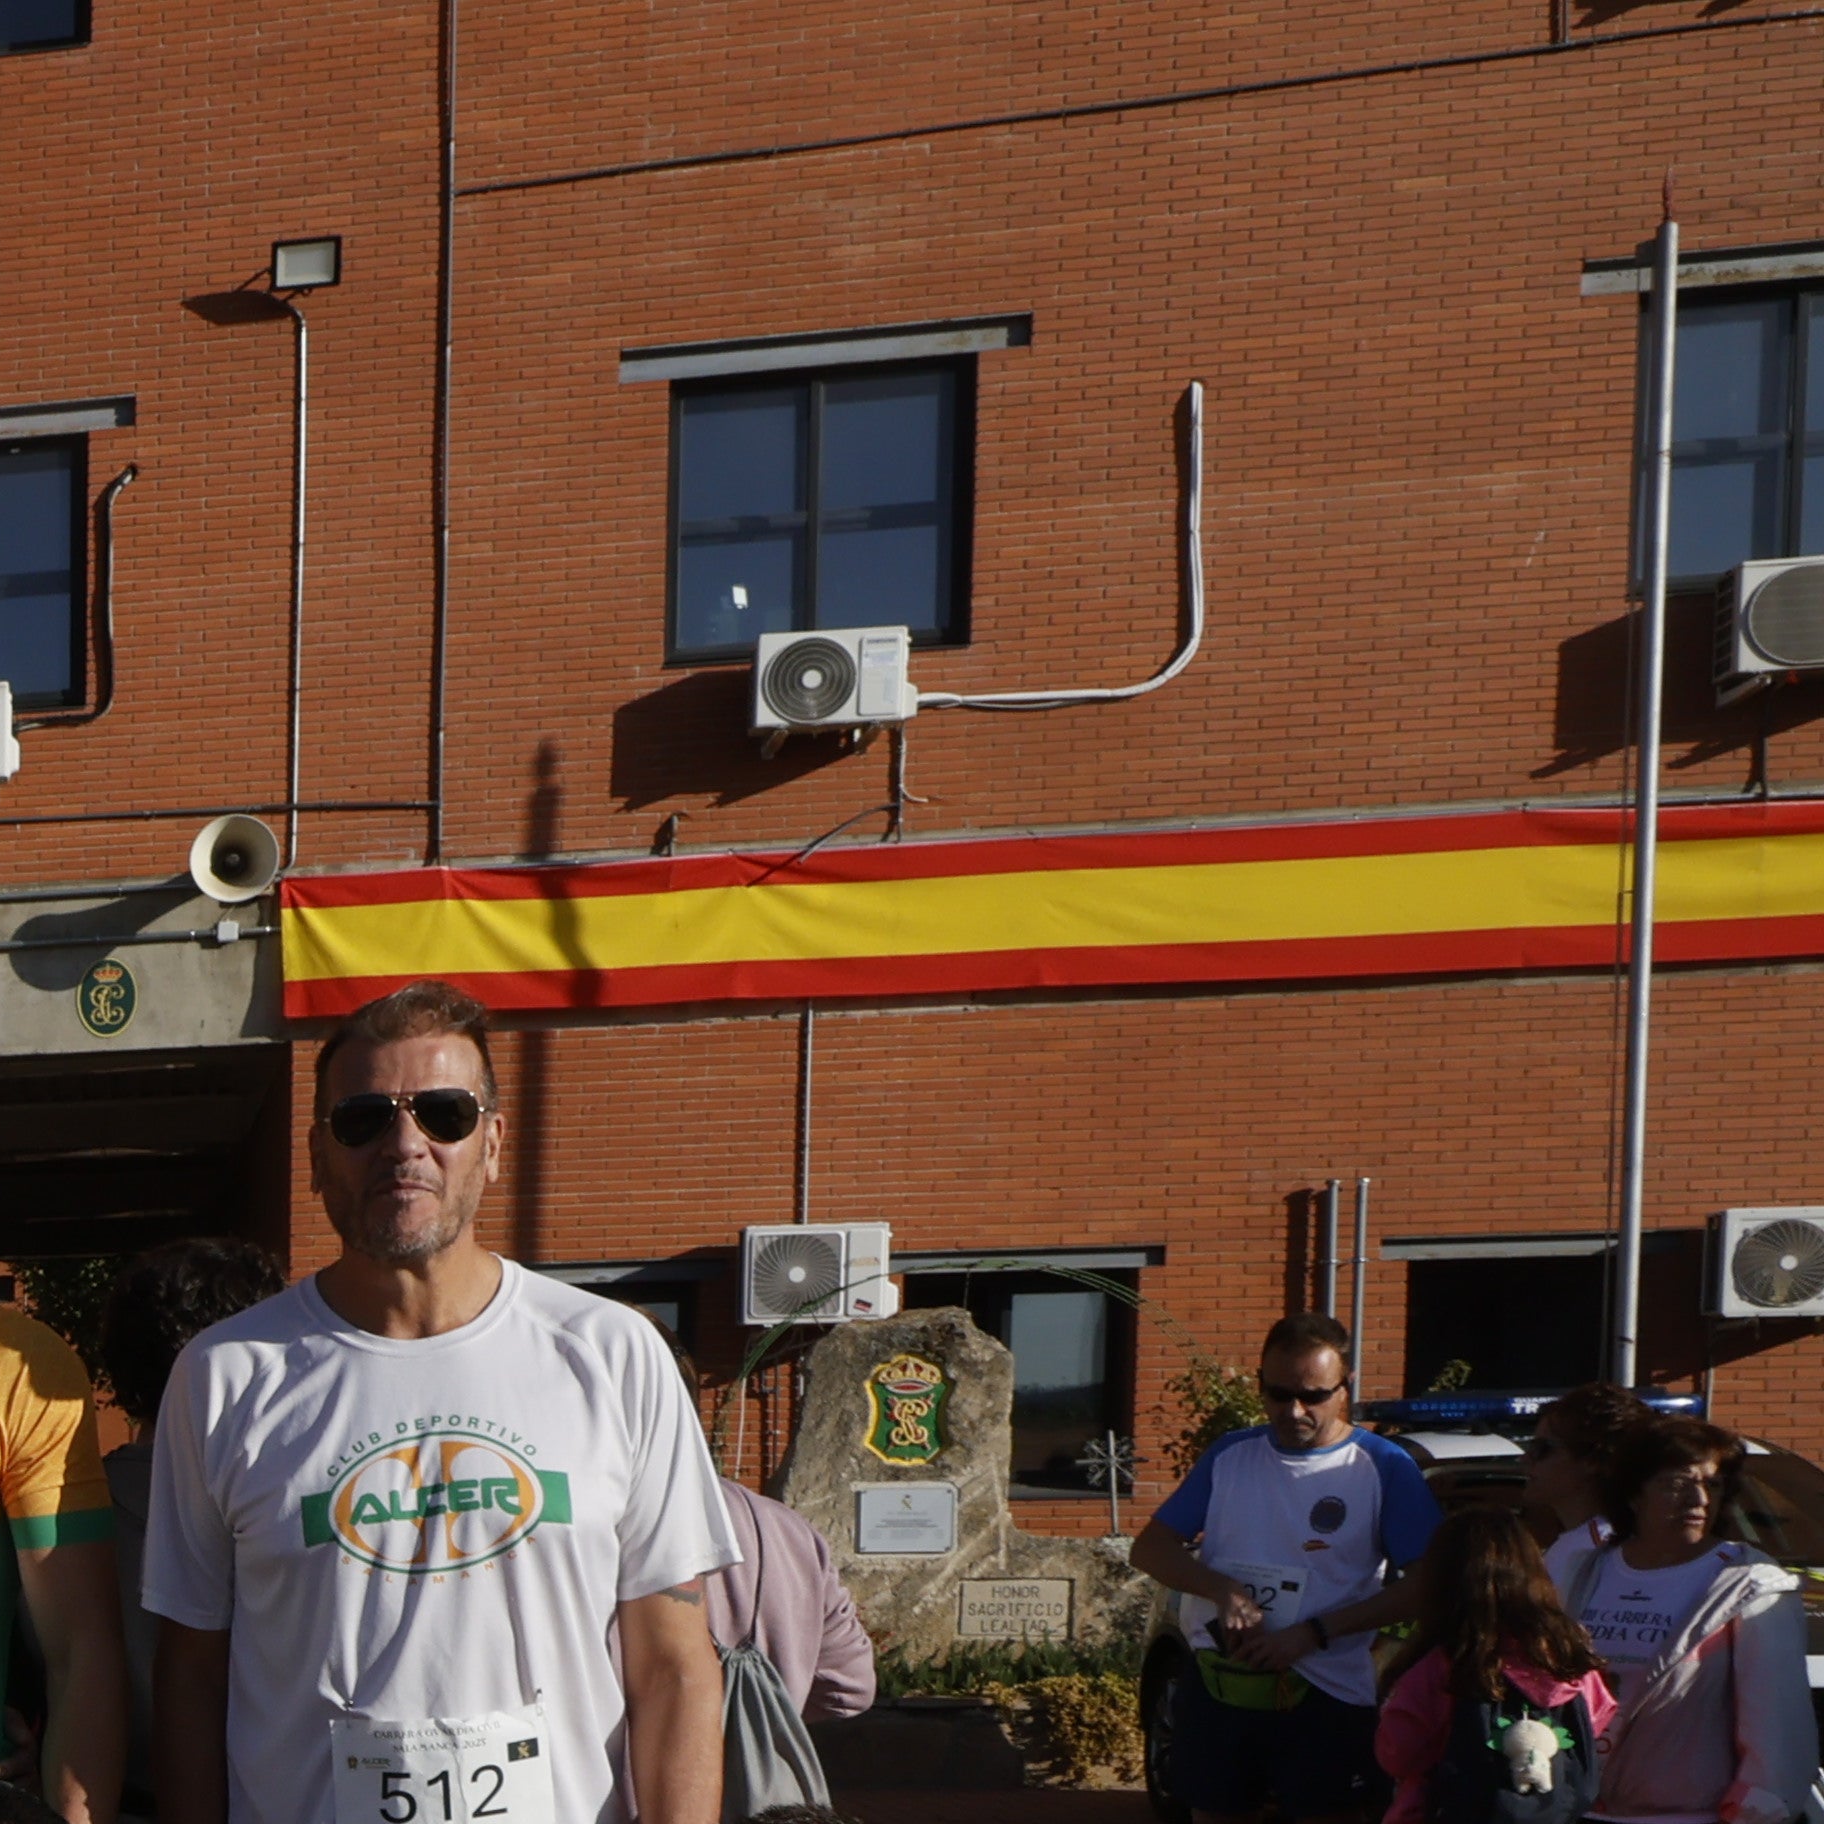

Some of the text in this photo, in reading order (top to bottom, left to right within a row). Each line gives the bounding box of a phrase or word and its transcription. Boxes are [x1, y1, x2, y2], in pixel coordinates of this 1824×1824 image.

[327, 1414, 538, 1478] CLUB DEPORTIVO
[349, 1477, 523, 1525] ALCER
[967, 1602, 1064, 1617] SACRIFICIO
[992, 1585, 1040, 1599] HONOR
[379, 1764, 507, 1824] 512
